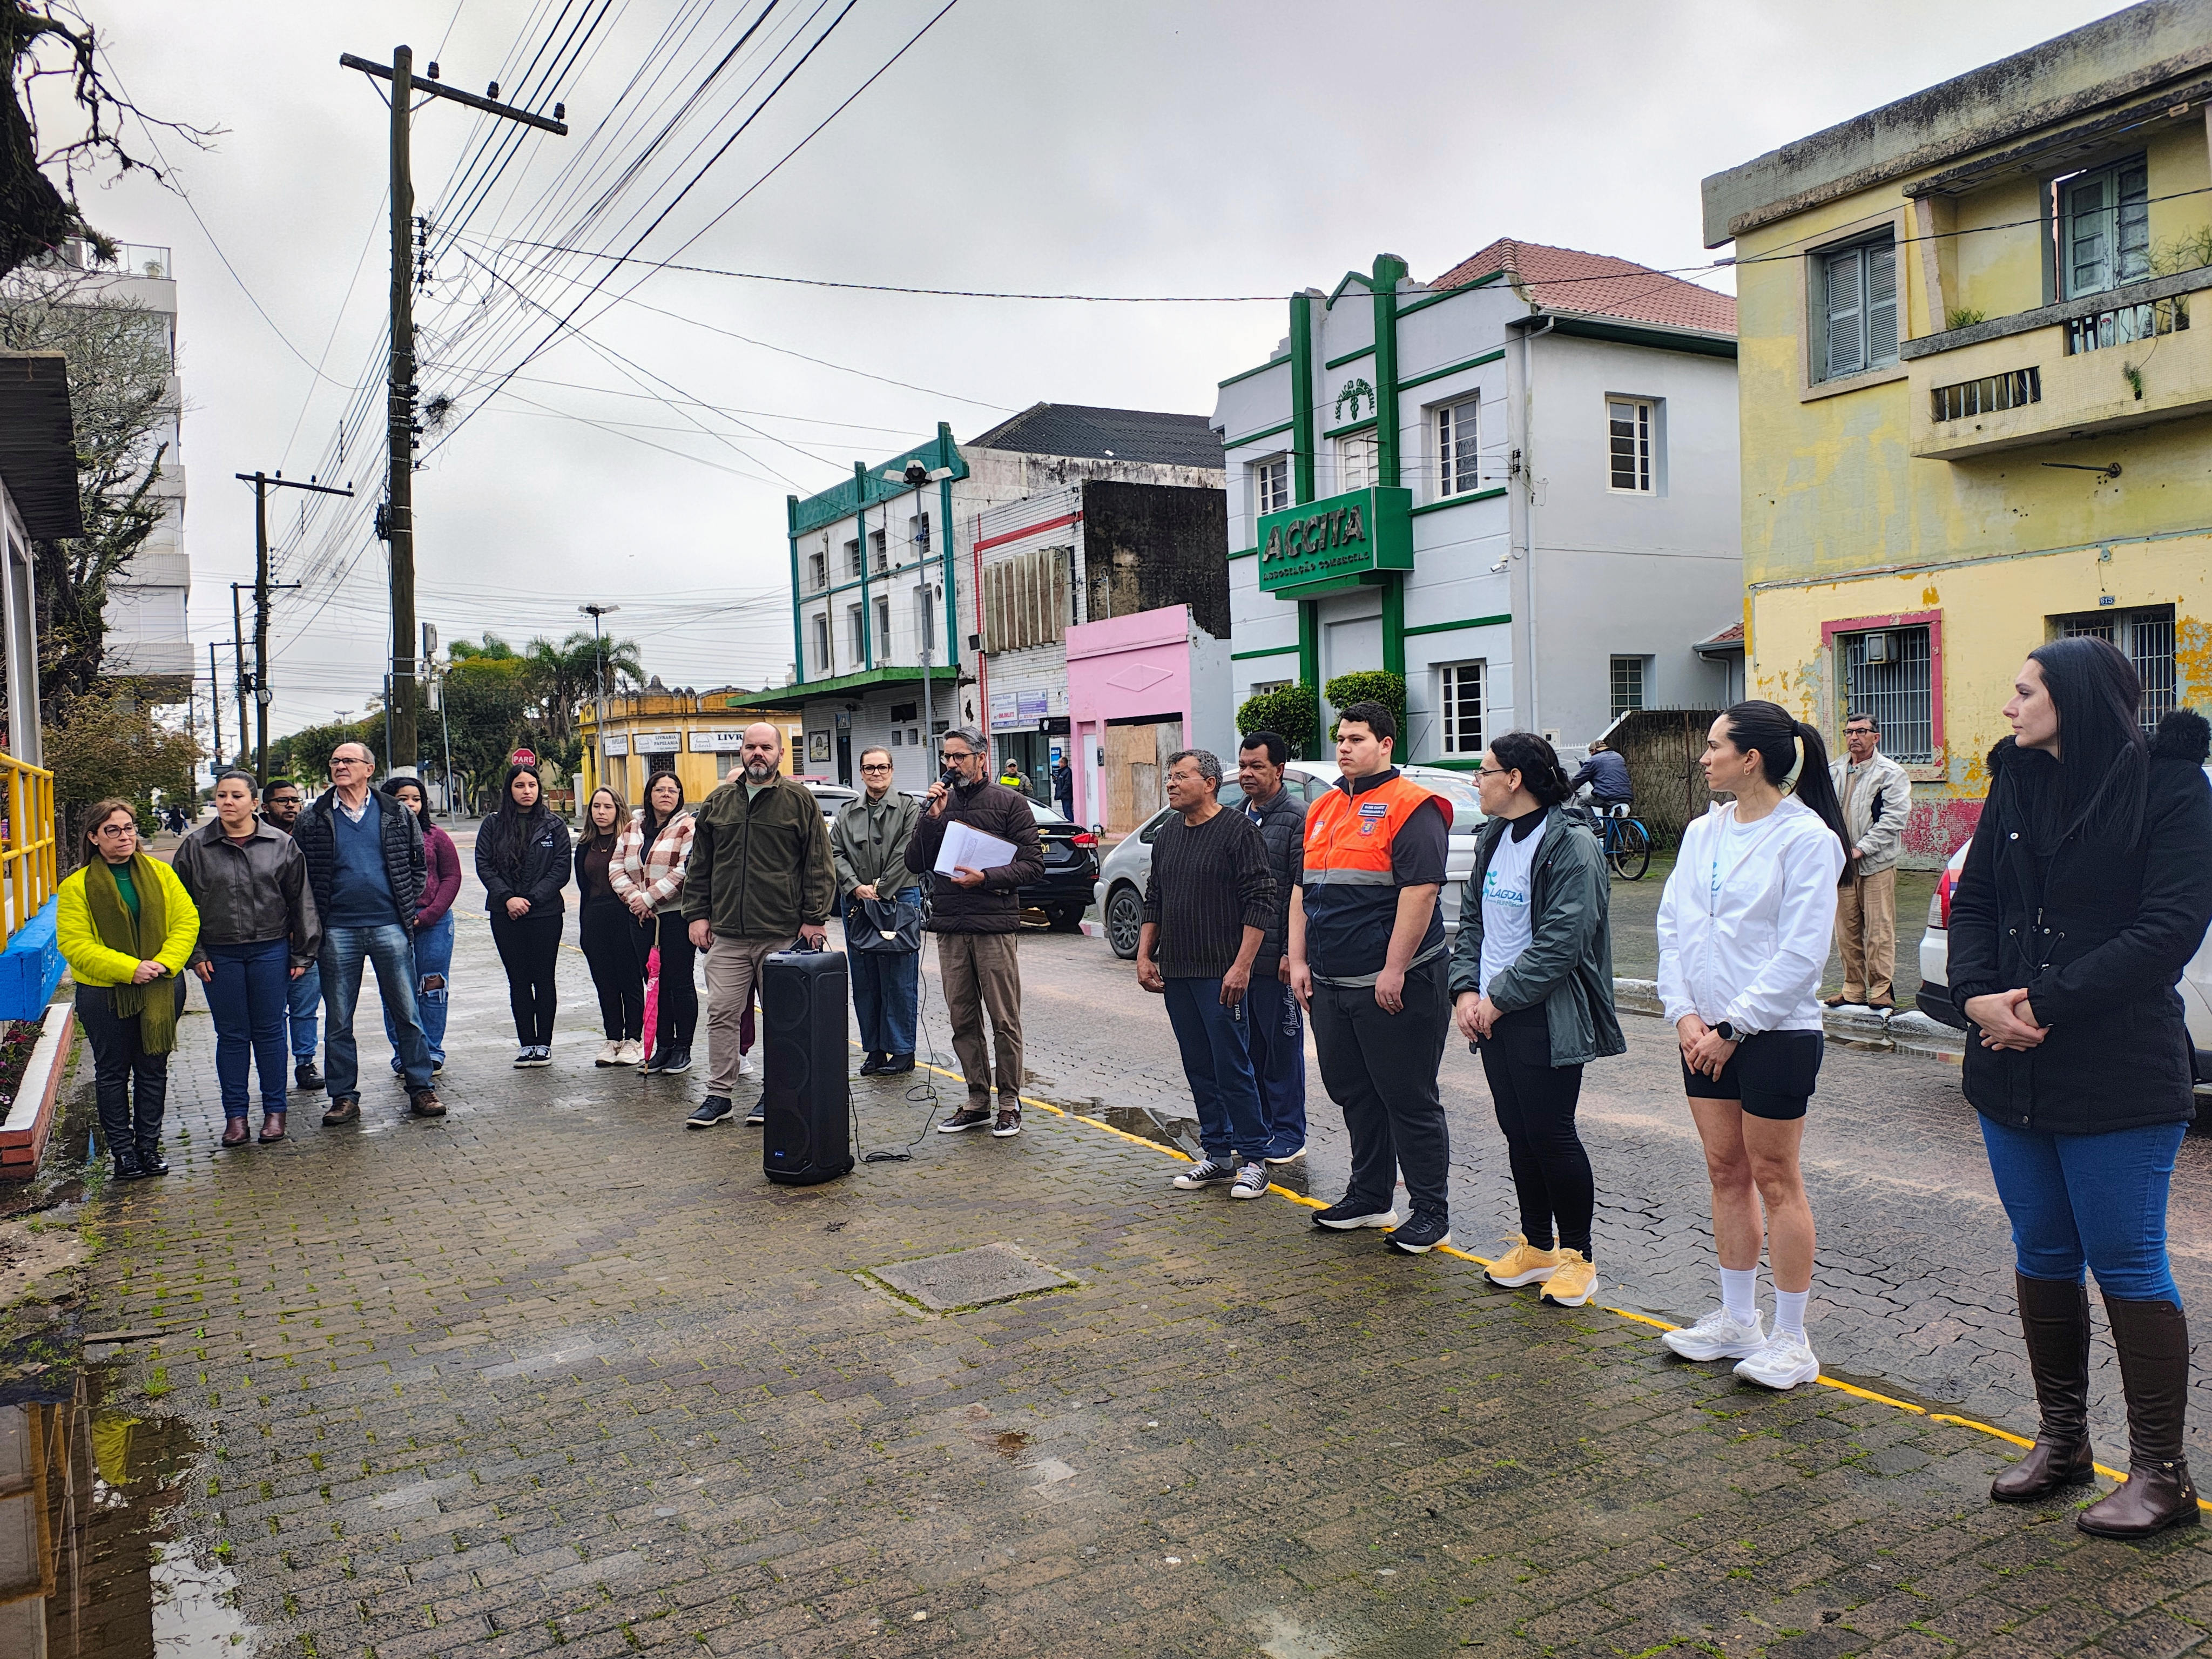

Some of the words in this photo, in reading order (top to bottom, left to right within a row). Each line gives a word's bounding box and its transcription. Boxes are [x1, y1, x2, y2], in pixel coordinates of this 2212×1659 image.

[1356, 378, 1375, 411] COMERCIAL
[1262, 504, 1366, 562] ACCITA
[1263, 561, 1316, 582] ASSOCIAÇÃO
[1318, 551, 1370, 569] COMERCIAL
[1489, 887, 1523, 902] LAGOA
